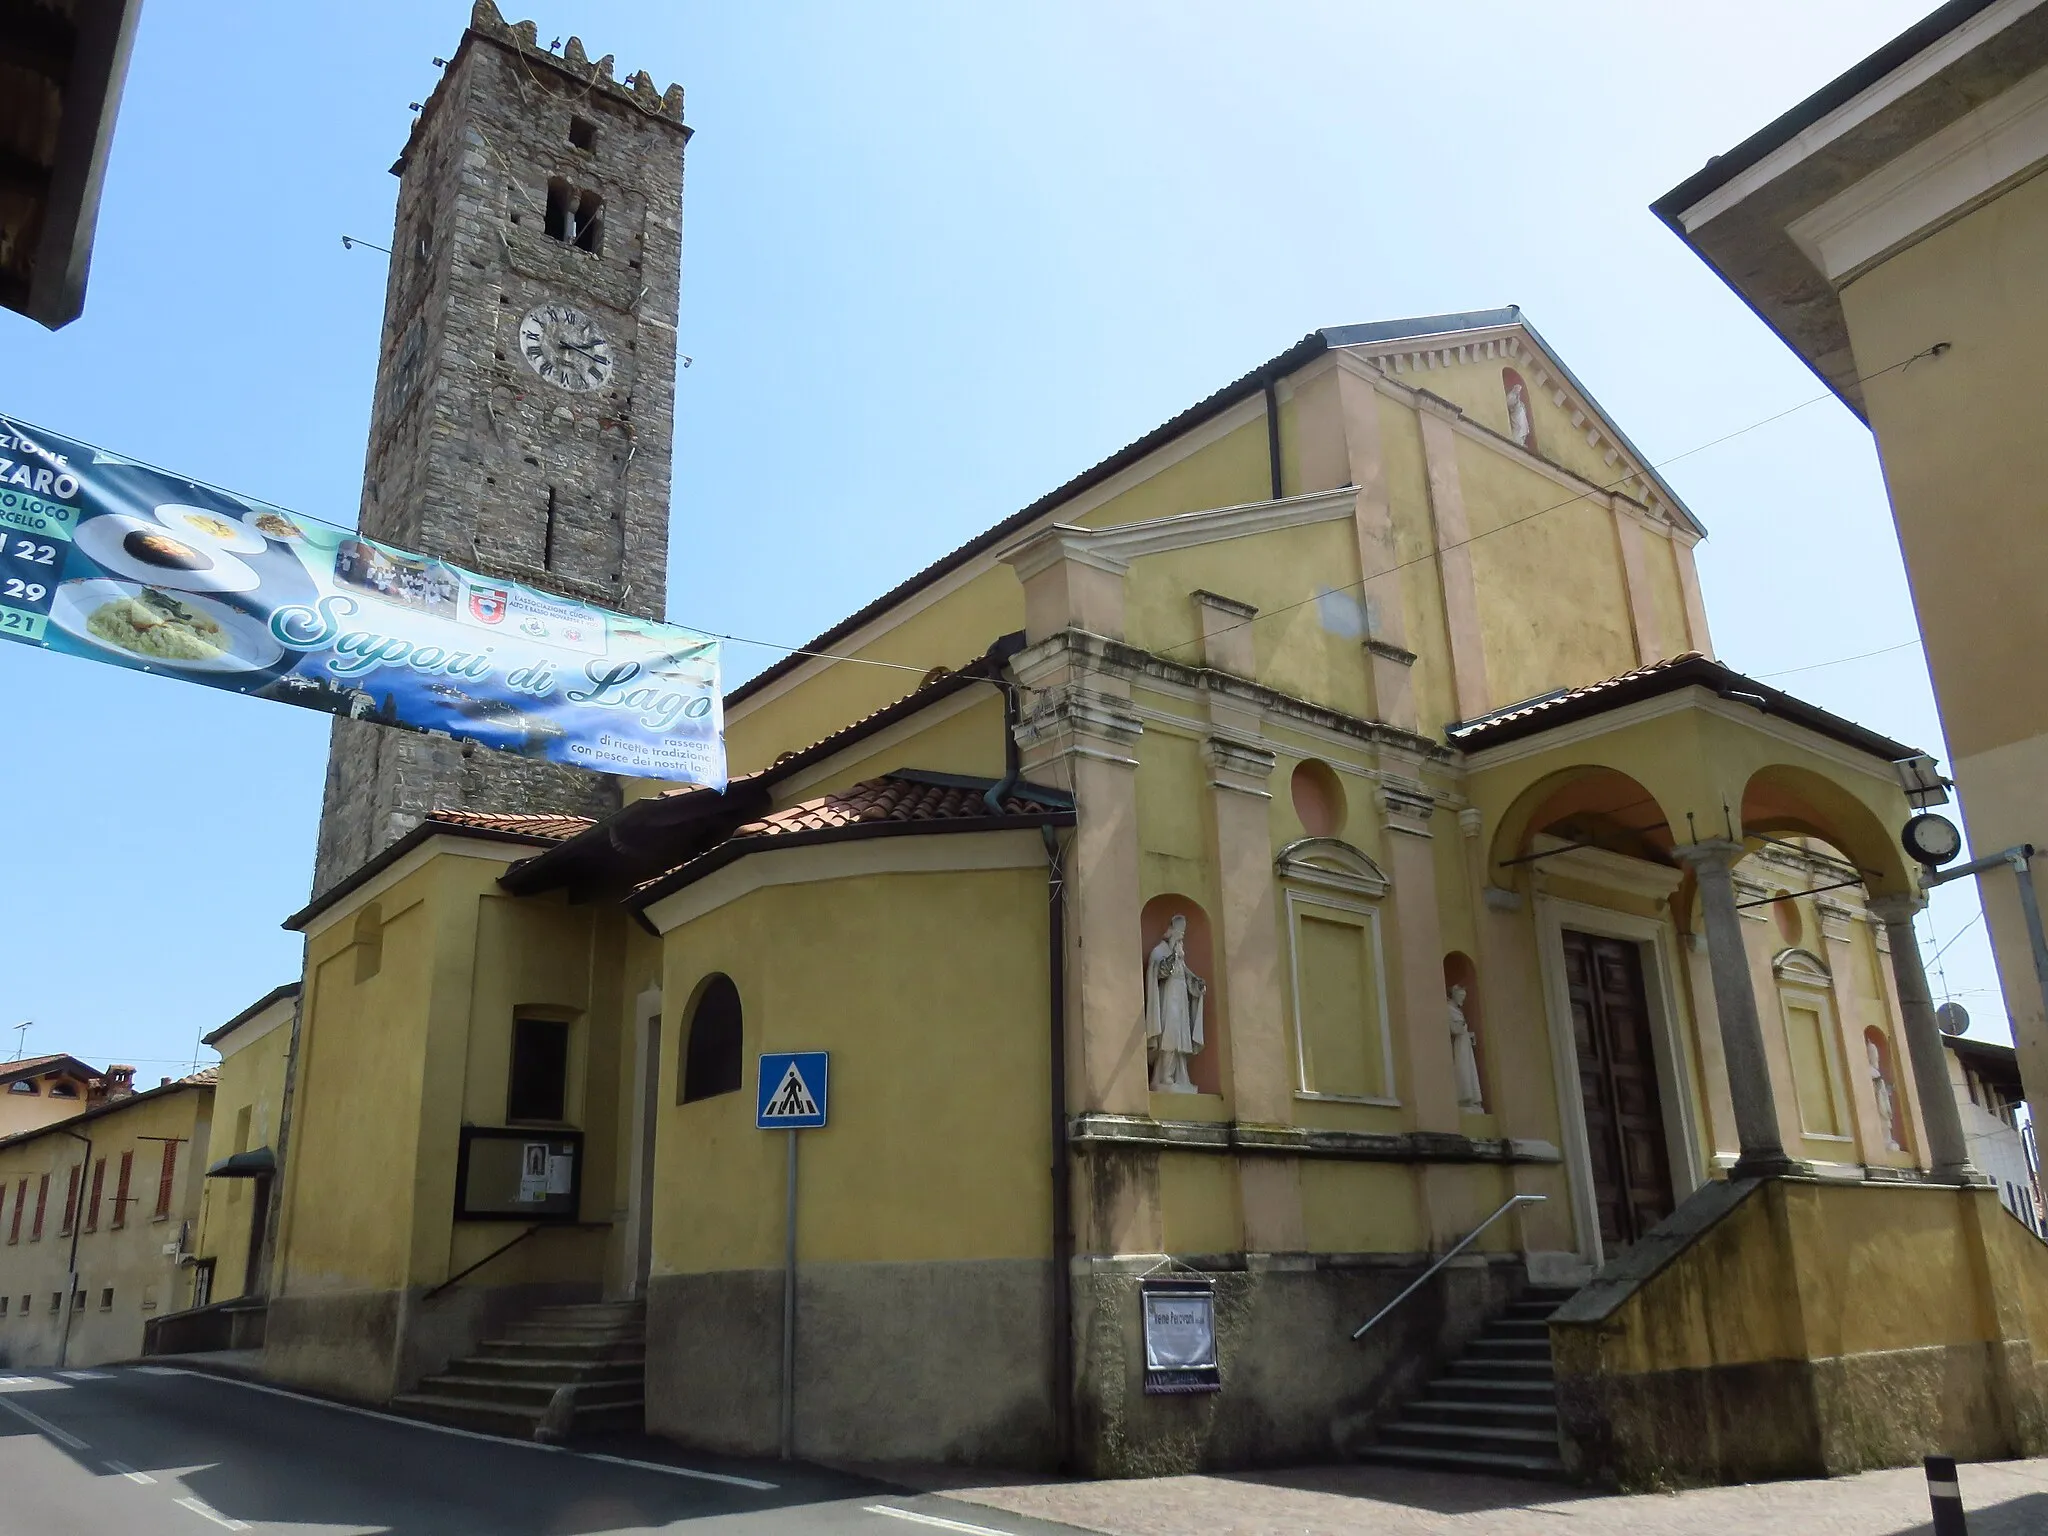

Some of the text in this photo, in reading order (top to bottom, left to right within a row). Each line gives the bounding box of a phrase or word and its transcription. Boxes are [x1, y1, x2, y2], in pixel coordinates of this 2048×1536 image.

[21, 498, 70, 521] LOCO
[14, 540, 56, 565] 22
[3, 578, 47, 602] 29
[270, 595, 493, 677] Sapori
[507, 659, 556, 692] di
[566, 657, 713, 729] Lago
[600, 734, 611, 746] di
[614, 739, 648, 755] ricette
[571, 743, 592, 755] con
[595, 748, 629, 763] pesce
[632, 755, 651, 766] dei
[654, 760, 687, 771] nostri
